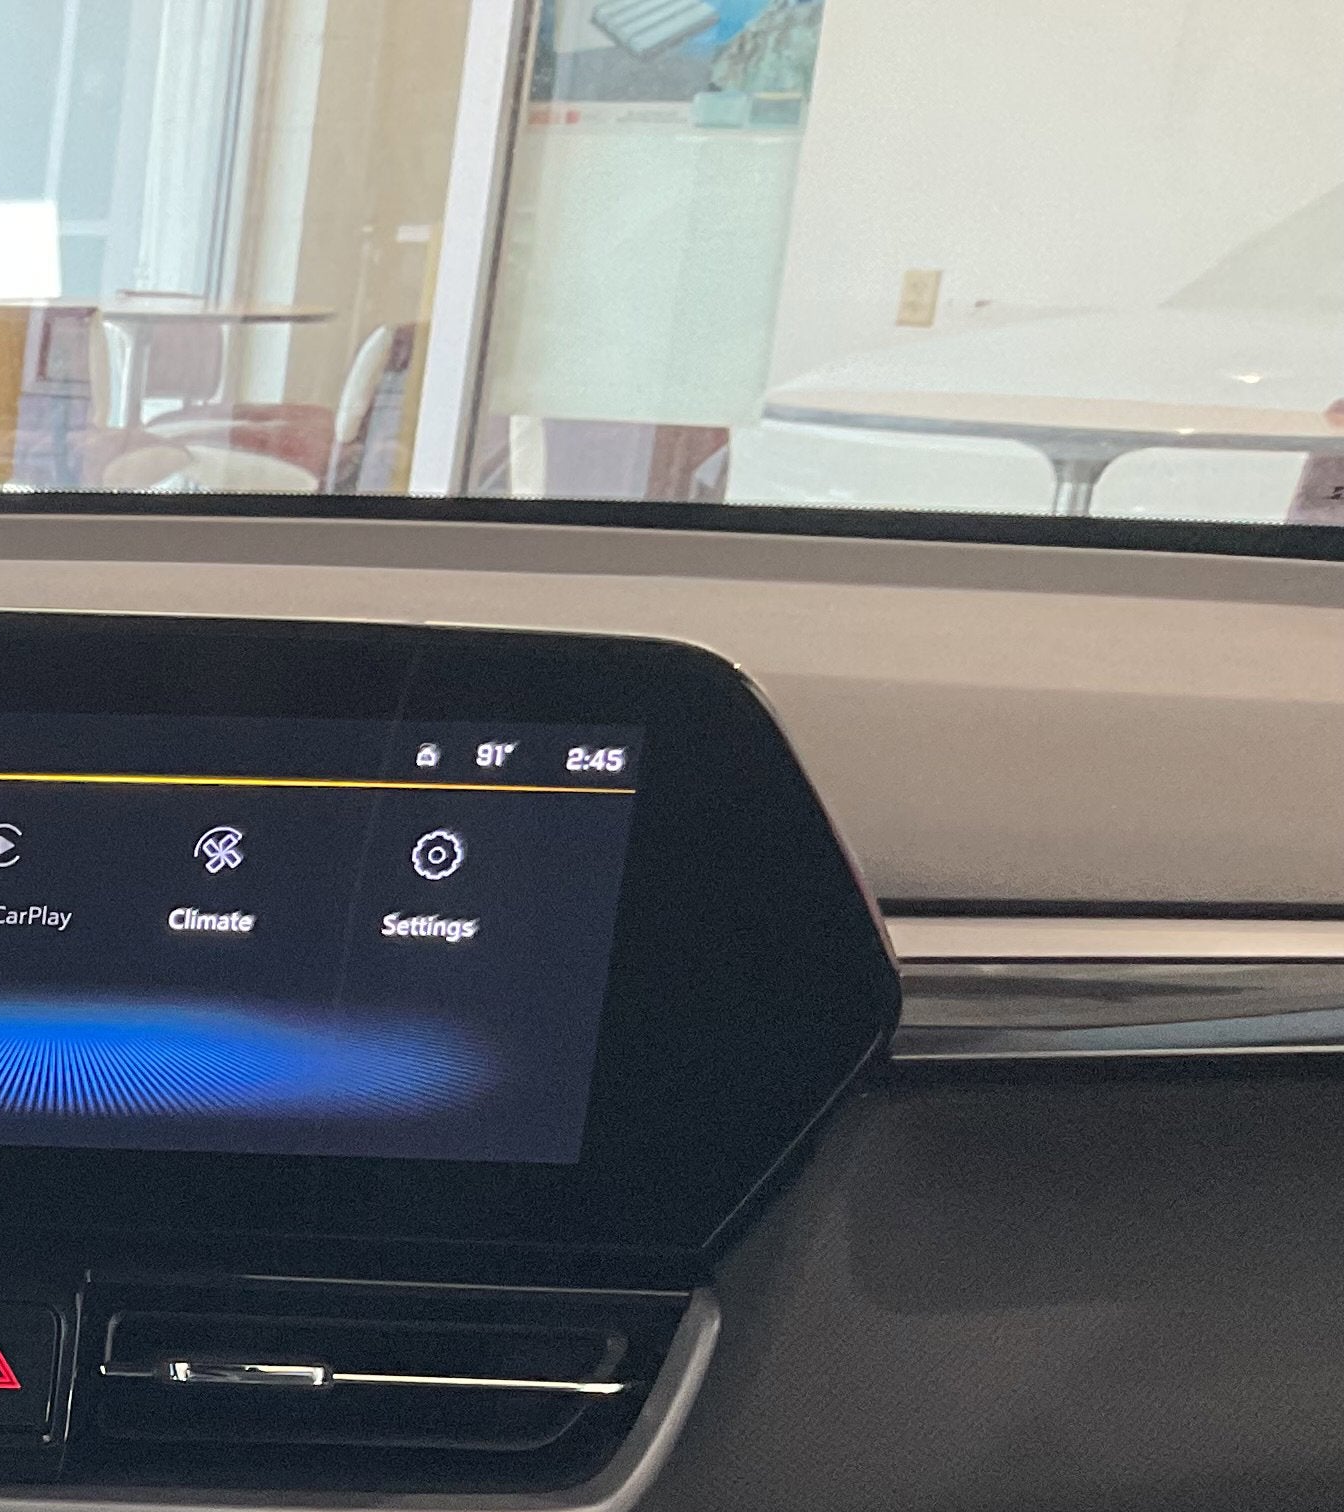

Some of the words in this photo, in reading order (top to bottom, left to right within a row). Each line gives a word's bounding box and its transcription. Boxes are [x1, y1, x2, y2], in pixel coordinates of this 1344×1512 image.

[564, 745, 628, 773] 2:45
[167, 907, 255, 933] Climate
[381, 913, 477, 941] Settings
